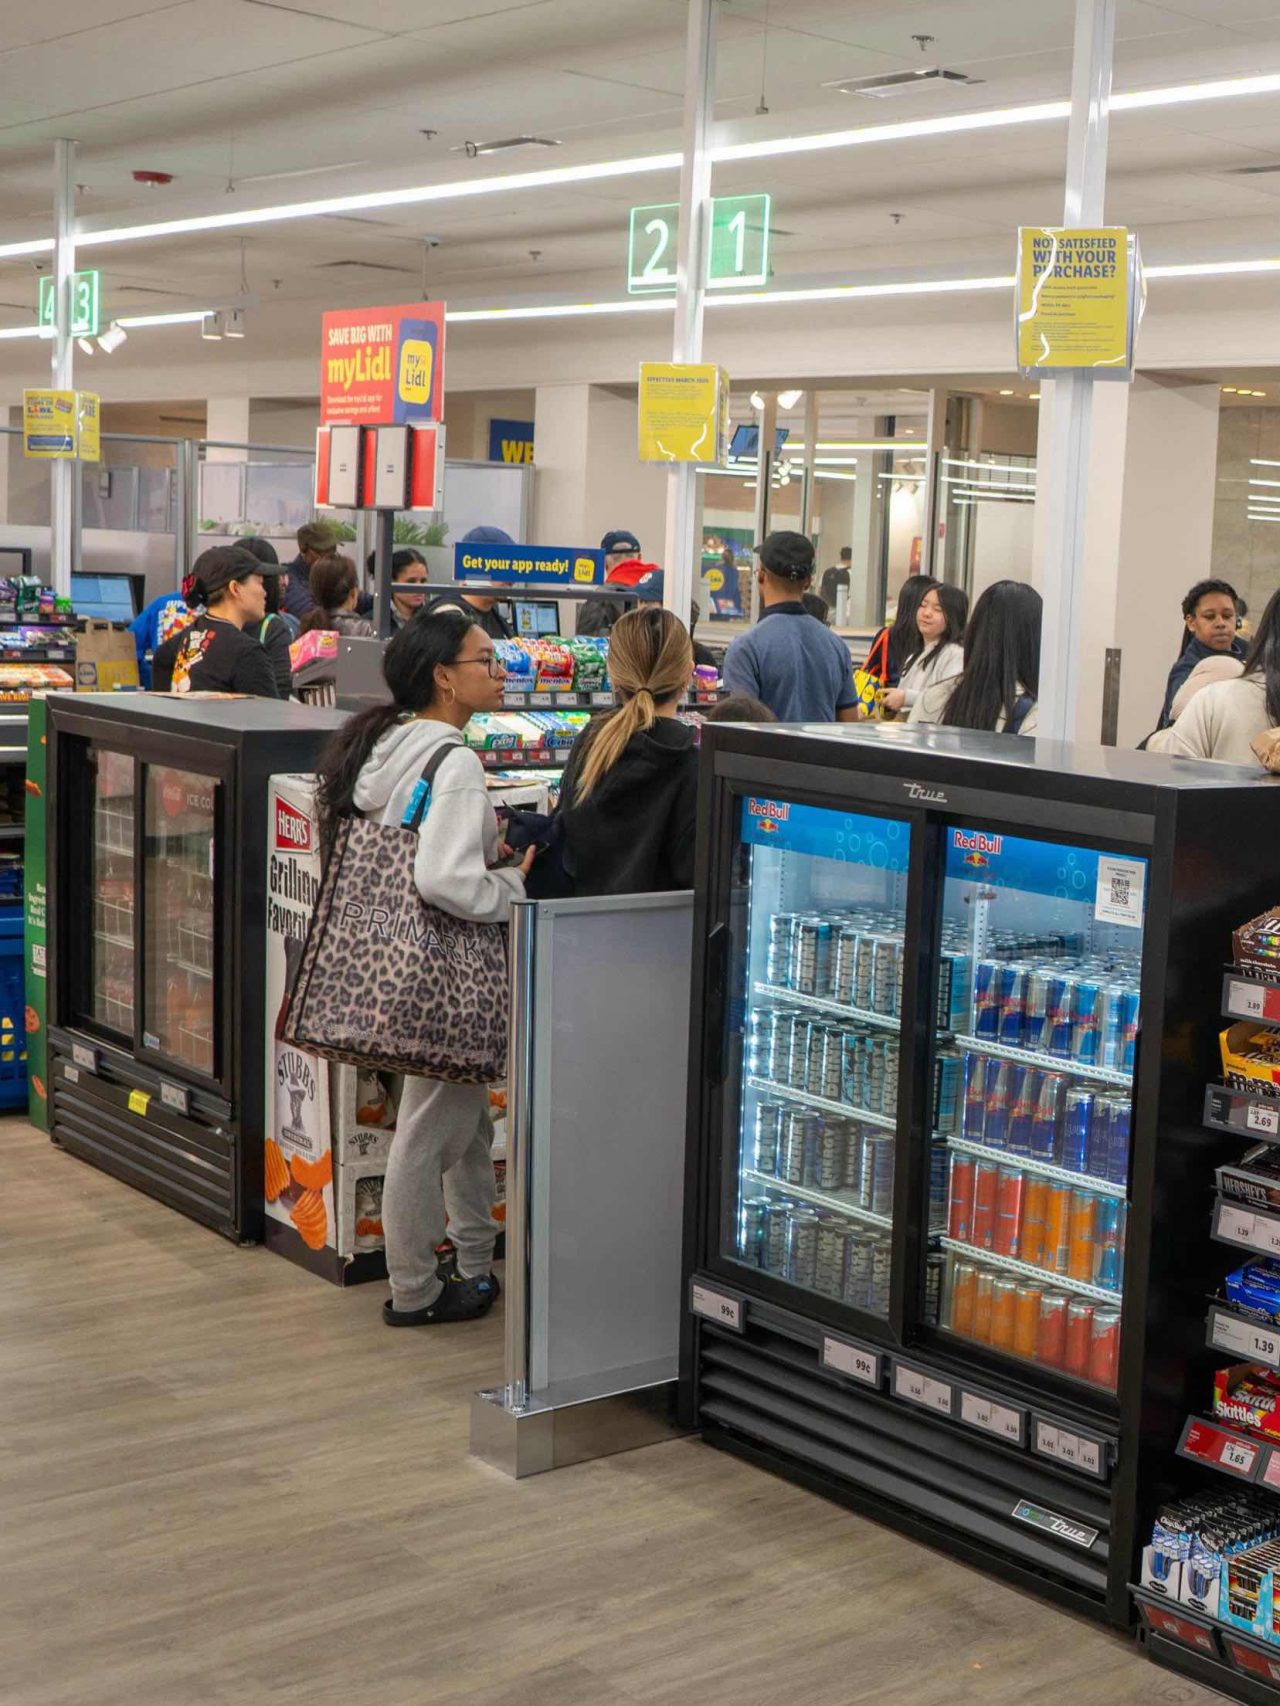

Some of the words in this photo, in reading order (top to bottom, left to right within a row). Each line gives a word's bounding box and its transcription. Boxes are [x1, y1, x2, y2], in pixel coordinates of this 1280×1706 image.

[643, 218, 669, 277] 2
[728, 211, 746, 272] 1
[1060, 238, 1117, 249] SATISFIED
[1076, 250, 1116, 263] YOUR
[77, 281, 90, 323] 3
[328, 326, 350, 346] SAVE
[351, 325, 367, 345] BIG
[367, 323, 392, 343] WITH
[328, 345, 392, 391] myLidl
[405, 368, 426, 387] Lidl
[502, 440, 534, 464] WE
[462, 554, 483, 568] Get
[484, 557, 511, 572] your
[512, 559, 534, 574] app
[535, 559, 570, 574] ready!
[540, 677, 570, 685] mentos
[748, 798, 768, 816] Red
[768, 802, 790, 821] Bull
[278, 810, 308, 845] HERR'S
[954, 831, 977, 849] Red
[978, 835, 1002, 855] Bull
[339, 901, 485, 963] PRIMARK
[277, 1051, 316, 1102] STUBB'S
[1254, 1115, 1272, 1128] 2.69
[1223, 1176, 1267, 1201] HERSHEY'S
[720, 1305, 735, 1319] 99¢
[1254, 1338, 1274, 1354] 1.39
[855, 1358, 871, 1374] 99¢
[1232, 1391, 1276, 1412] Skittle
[1216, 1401, 1262, 1427] Skittles
[1228, 1452, 1246, 1465] 1.65
